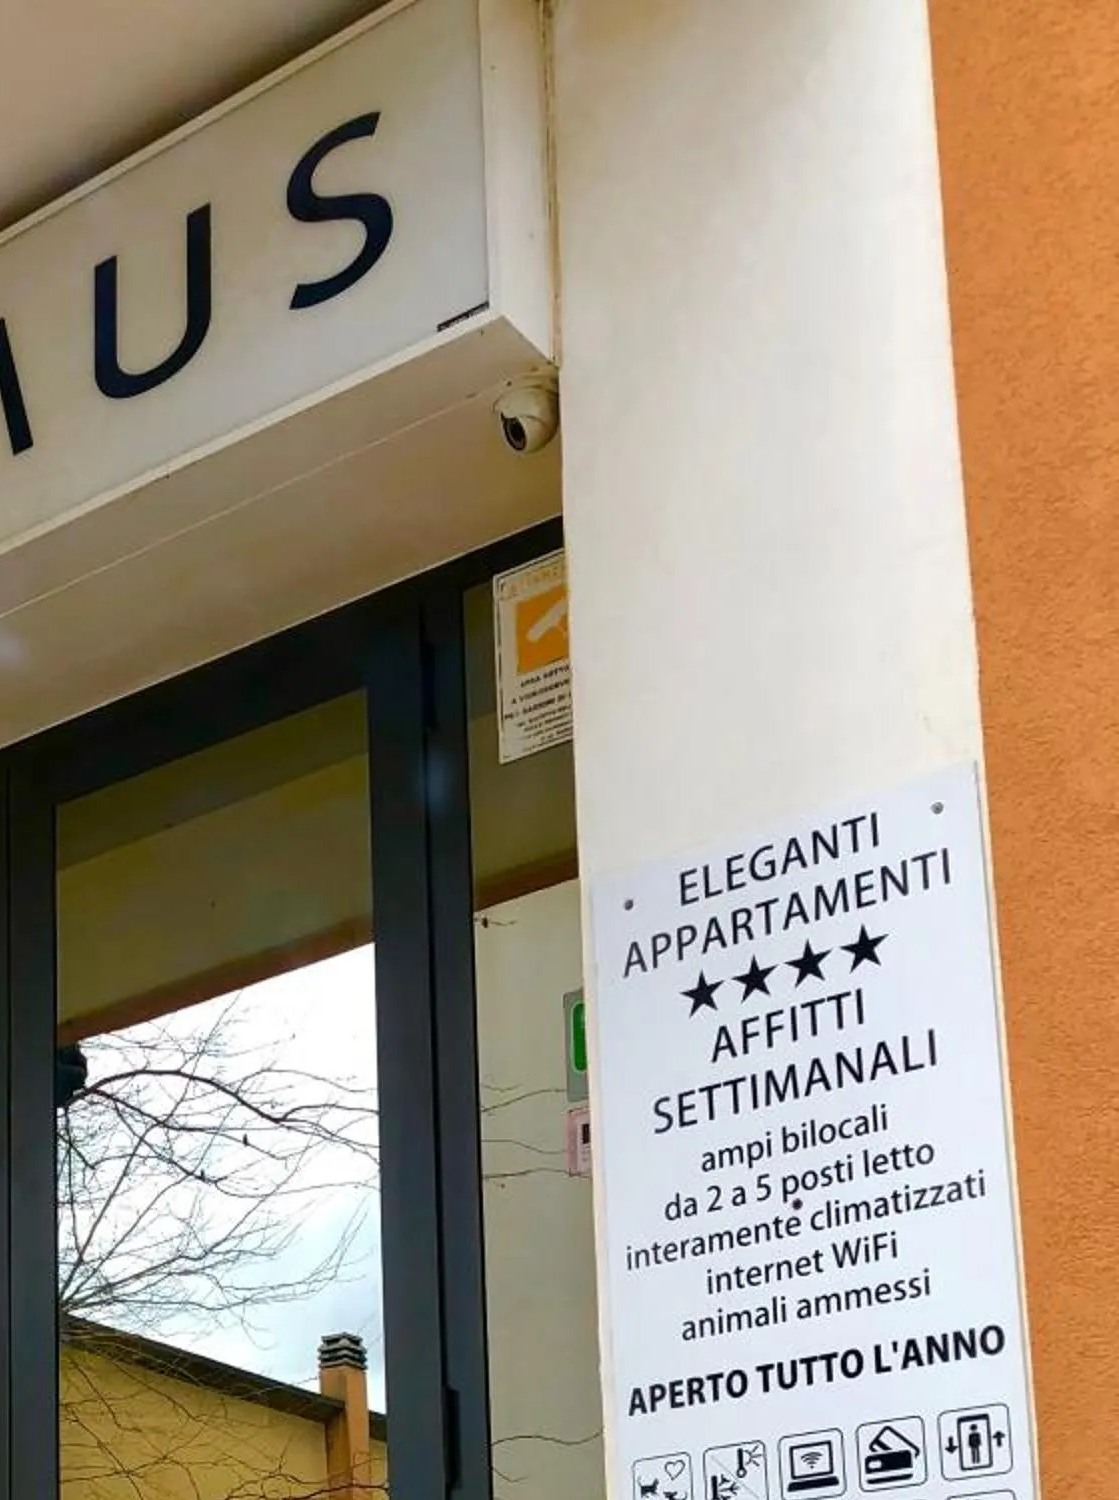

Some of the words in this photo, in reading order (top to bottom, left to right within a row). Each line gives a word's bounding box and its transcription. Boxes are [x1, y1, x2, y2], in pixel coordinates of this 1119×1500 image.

[678, 811, 880, 907] ELEGANTI
[622, 847, 951, 979] APPARTAMENTI
[710, 987, 865, 1064] AFFITTI
[653, 1027, 938, 1135] SETTIMANALI
[700, 1130, 773, 1173] ampi
[781, 1103, 888, 1155] bilocali
[626, 1215, 802, 1272] interamente
[809, 1168, 986, 1232] climatizzati
[664, 1191, 698, 1222] da
[706, 1184, 724, 1213] 2
[731, 1185, 747, 1207] a
[756, 1173, 772, 1202] 5
[781, 1153, 854, 1204] posti
[862, 1143, 935, 1178] letto
[681, 1295, 788, 1342] animali
[796, 1267, 931, 1320] ammessi
[706, 1249, 825, 1295] internet
[830, 1230, 898, 1269] WiFi
[628, 1369, 749, 1417] APERTO
[755, 1348, 865, 1394] TUTTO
[873, 1324, 1006, 1375] L'ANNO
